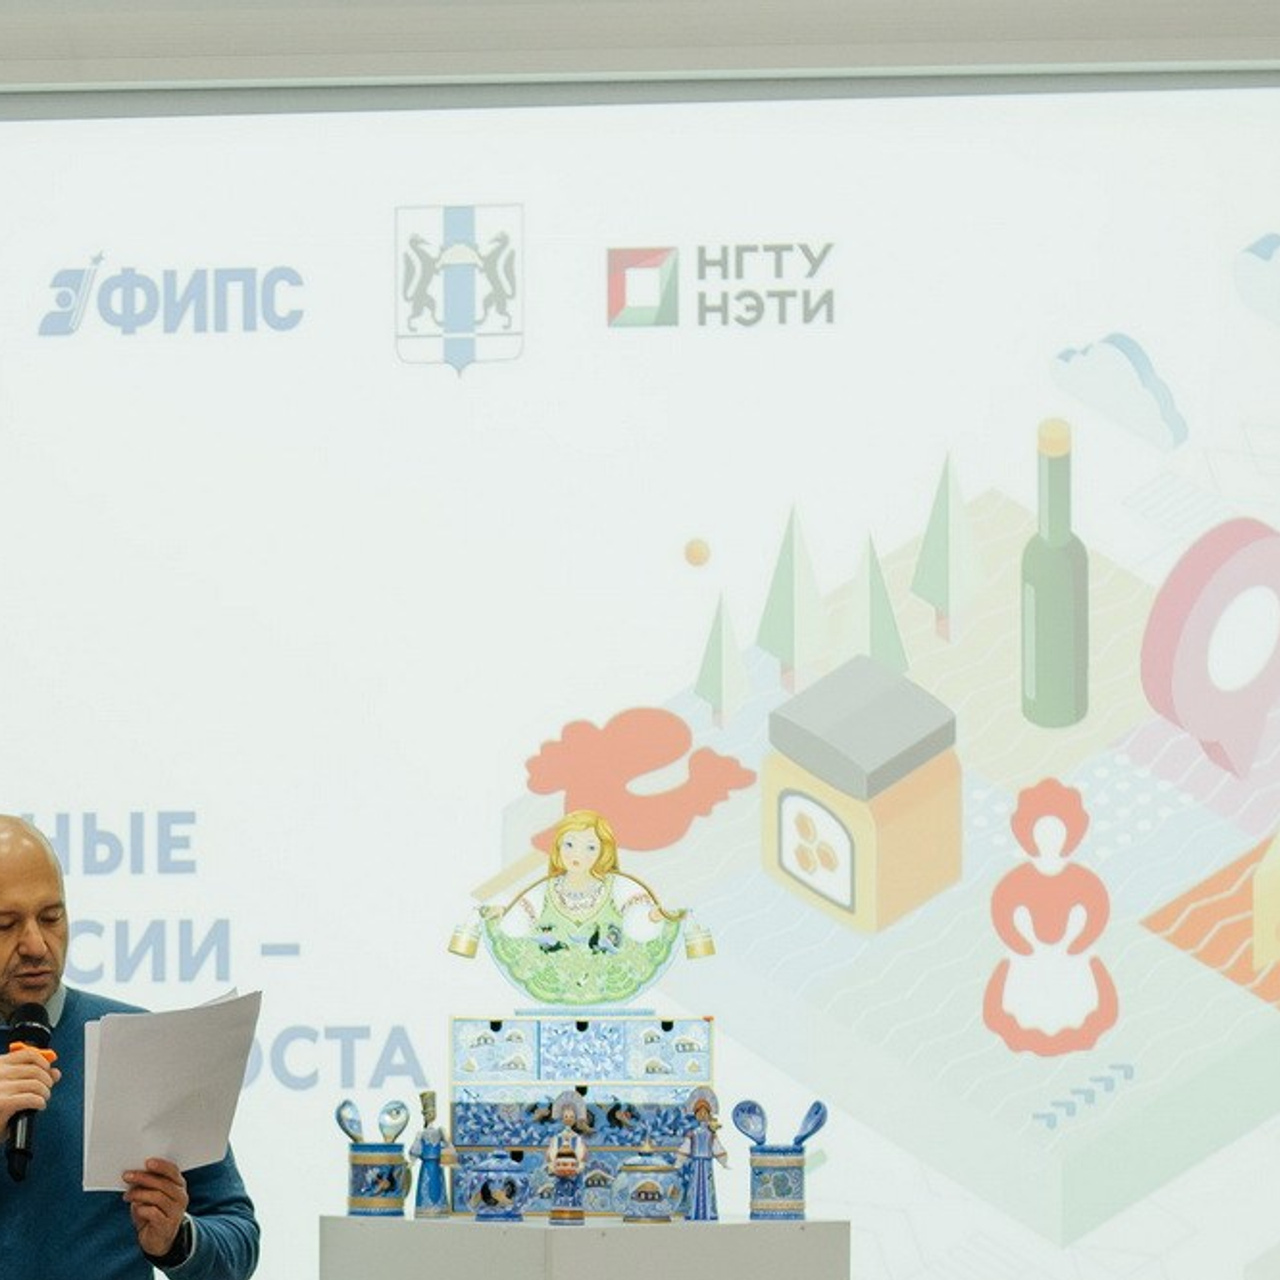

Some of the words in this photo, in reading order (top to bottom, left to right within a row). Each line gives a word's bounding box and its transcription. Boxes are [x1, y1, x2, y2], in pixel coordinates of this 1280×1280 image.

[696, 242, 835, 281] НГТУ
[96, 265, 305, 336] ФИПС
[696, 288, 835, 328] НЭТИ
[243, 1025, 431, 1092] СТА
